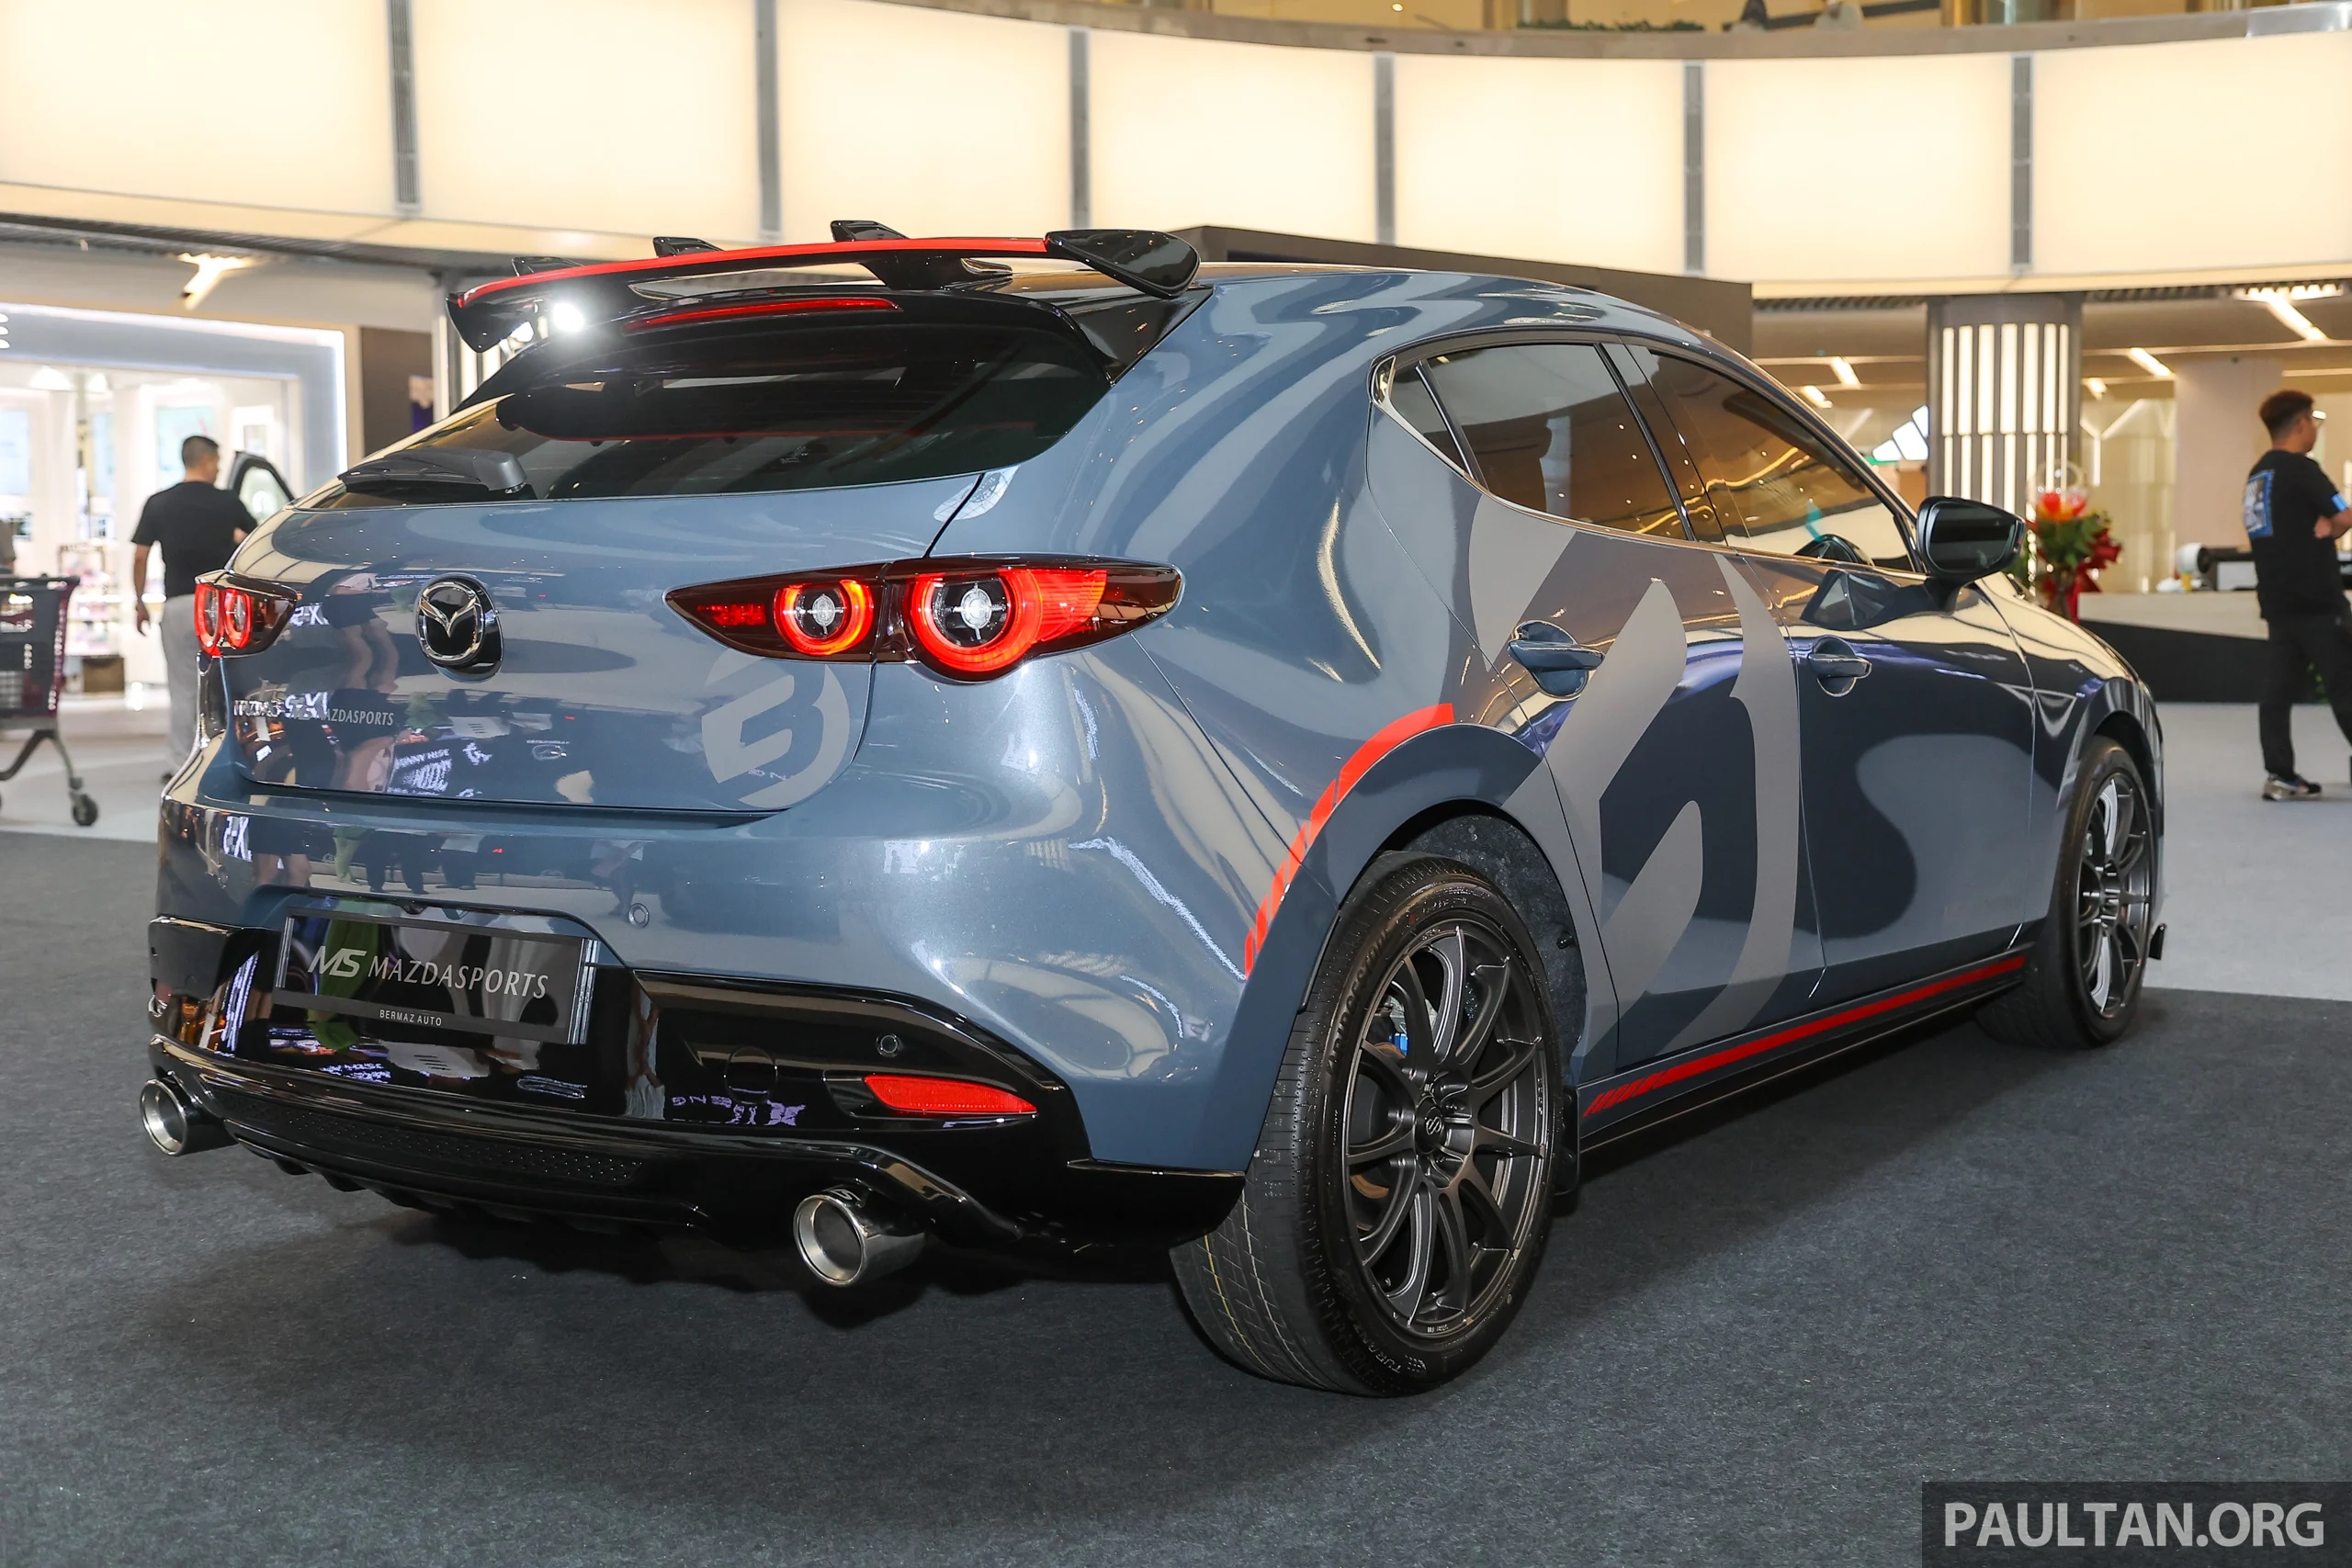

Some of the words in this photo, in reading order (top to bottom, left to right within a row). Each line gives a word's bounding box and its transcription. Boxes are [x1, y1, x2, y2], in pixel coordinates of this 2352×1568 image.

[307, 945, 368, 978] MS
[368, 955, 548, 999] MAZDASPORTS
[379, 1010, 415, 1022] BERMAZ
[416, 1014, 442, 1026] AUTO
